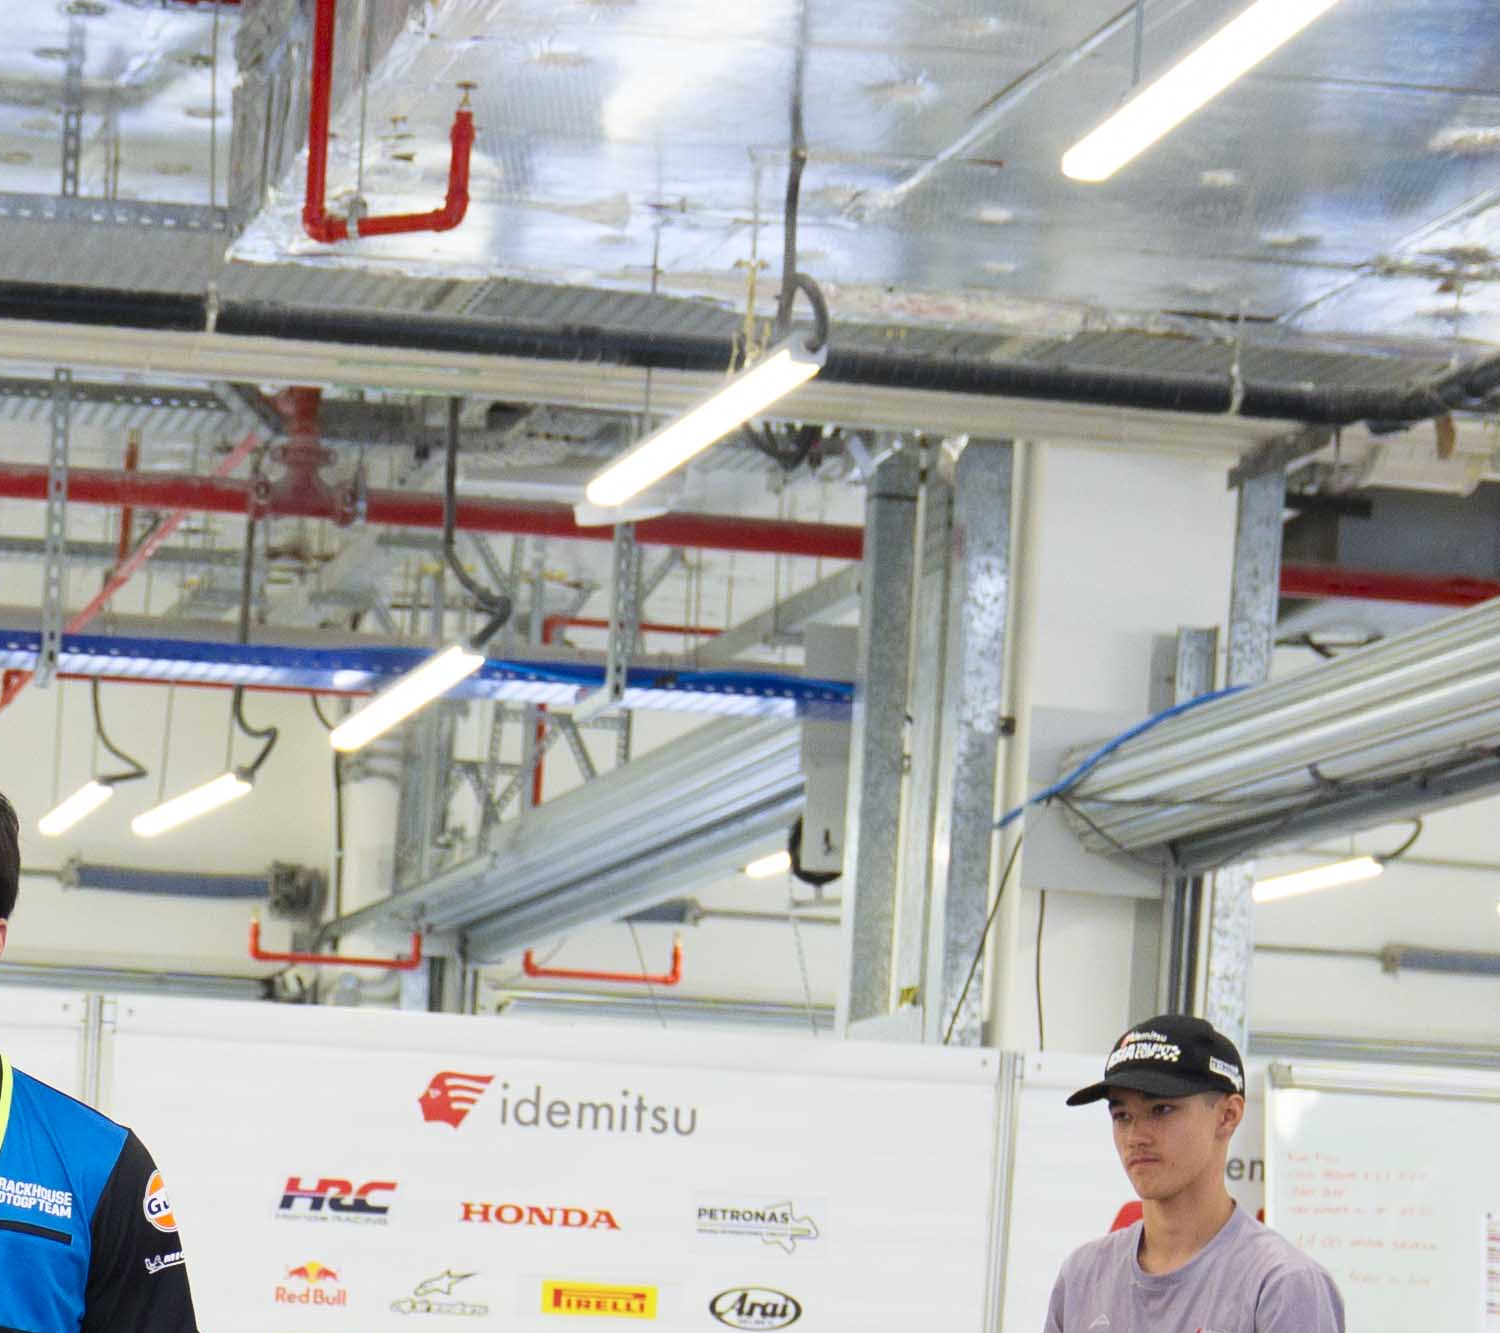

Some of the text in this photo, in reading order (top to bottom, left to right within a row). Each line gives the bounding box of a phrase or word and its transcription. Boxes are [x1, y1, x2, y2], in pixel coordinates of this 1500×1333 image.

[500, 1082, 697, 1136] idemitsu
[38, 1198, 73, 1219] TEAM
[279, 1177, 397, 1215] HRC
[461, 1202, 621, 1230] HONDA
[697, 1207, 790, 1226] PETRONAS
[553, 1288, 648, 1314] PIRELLI
[722, 1292, 791, 1320] Arai
